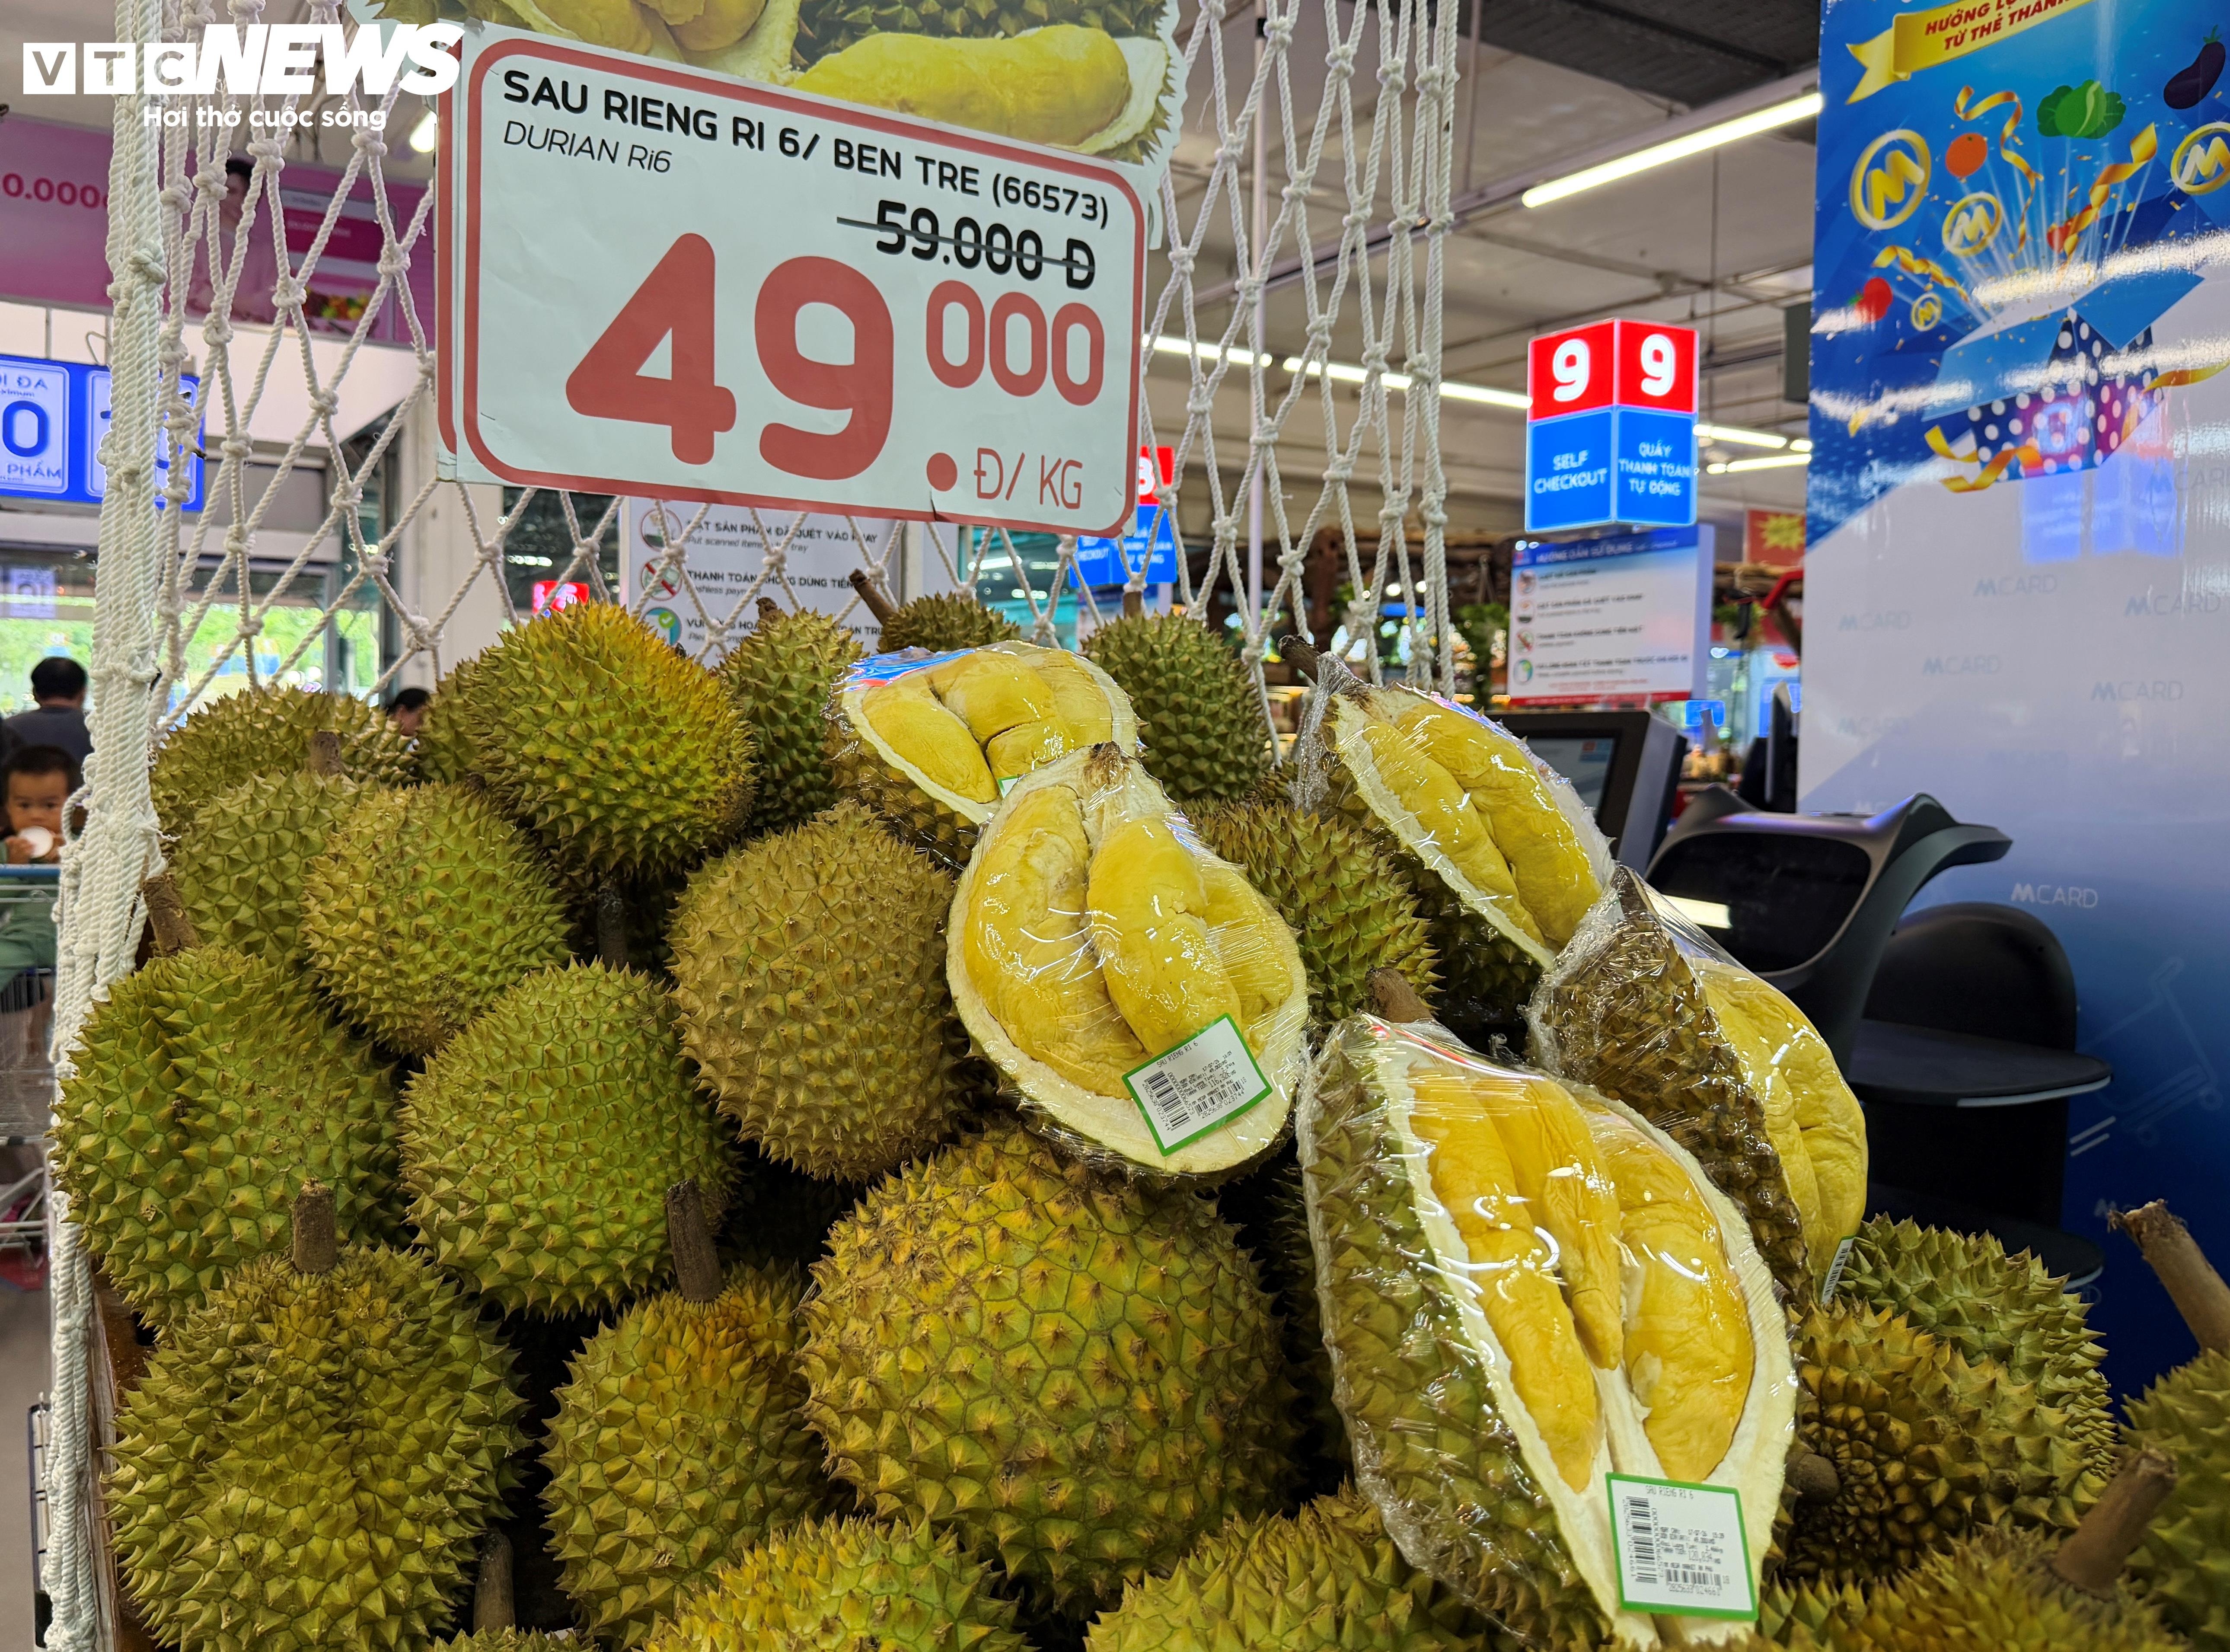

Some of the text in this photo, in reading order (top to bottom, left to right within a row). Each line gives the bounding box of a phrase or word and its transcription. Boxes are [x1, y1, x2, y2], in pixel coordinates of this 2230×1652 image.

[1925, 3, 1990, 35] HƯỞNG
[1944, 29, 1967, 50] TỪ
[1971, 13, 2003, 41] THẺ
[504, 121, 673, 173] DURIAN Ri6
[504, 70, 1109, 230] SAU RIENG RI 6/ BEN TRE (66573)
[3, 172, 108, 209] 0.000
[876, 200, 1043, 280] 59.000
[1553, 338, 1590, 402] 9
[1641, 334, 1676, 396] 9
[1553, 450, 1589, 471] SELF
[1618, 459, 1658, 475] THANH
[1040, 455, 1083, 510] KG
[1534, 468, 1608, 494] CHECKOUT
[2010, 882, 2099, 908] MCARD
[1156, 1058, 1168, 1068] SAU
[1167, 1048, 1184, 1062] RIENG
